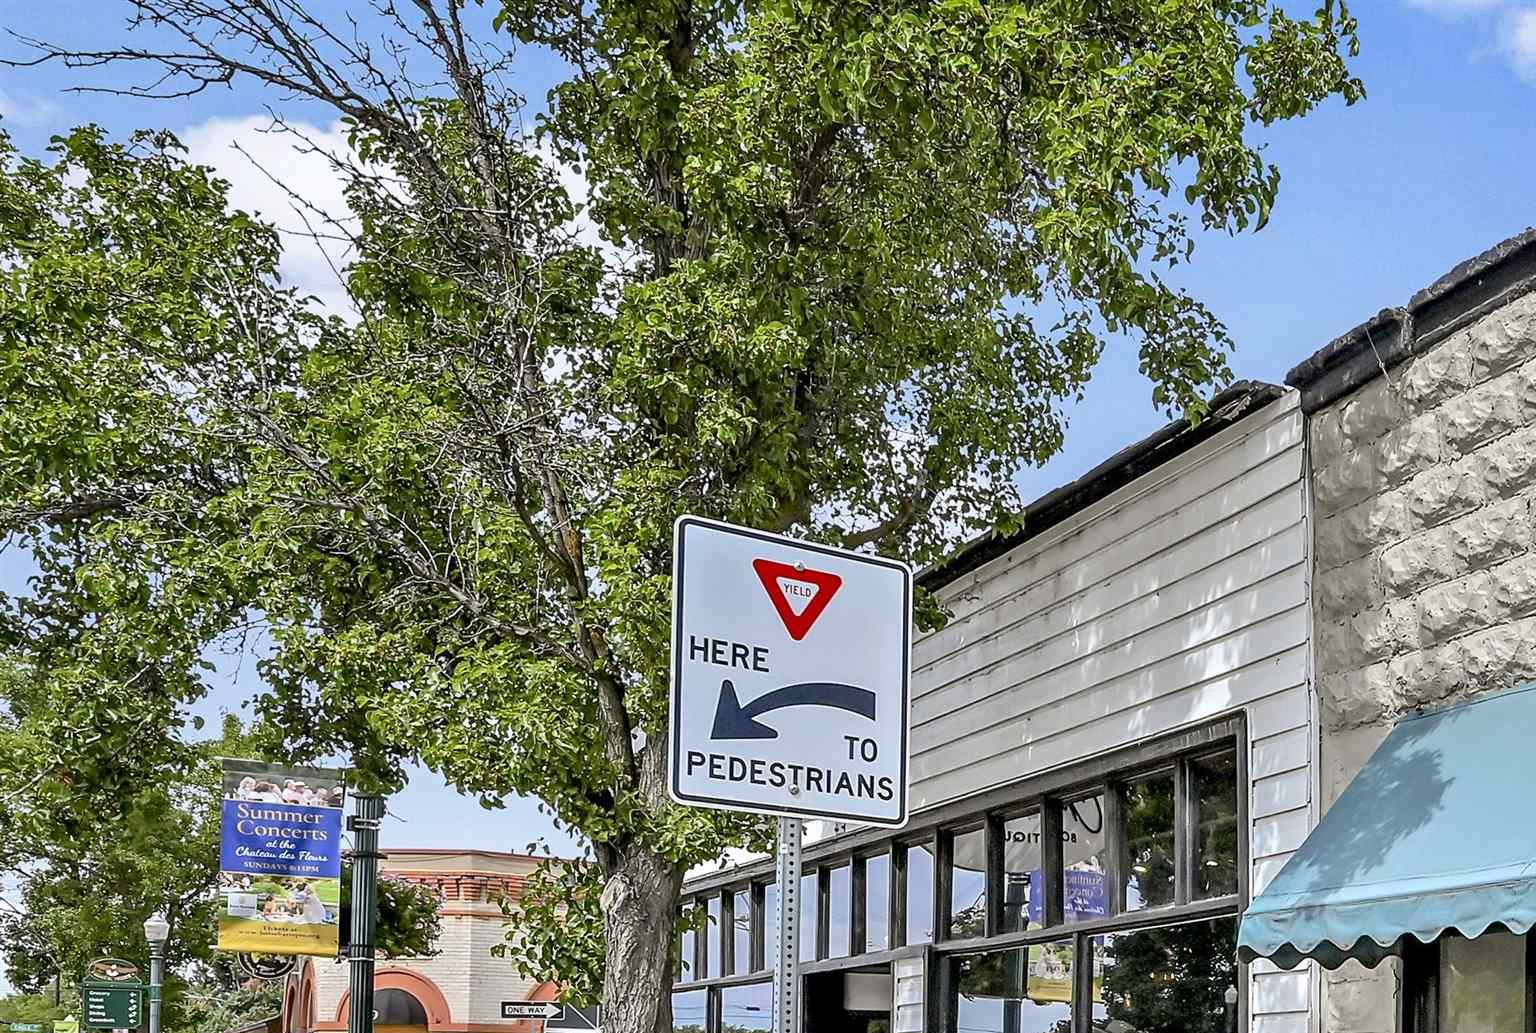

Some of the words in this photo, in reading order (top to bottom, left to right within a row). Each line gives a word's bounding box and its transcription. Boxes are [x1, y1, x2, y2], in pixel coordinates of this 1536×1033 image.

[783, 583, 811, 597] YIELD
[689, 635, 769, 673] HERE
[844, 735, 877, 763] TO
[687, 751, 893, 801] PEDESTRIANS
[237, 803, 324, 824] Summer
[237, 820, 328, 841] Concerts
[235, 846, 277, 858] Chateau
[279, 850, 296, 860] des
[266, 840, 278, 848] at
[279, 840, 296, 850] the
[507, 1006, 524, 1014] ONE
[527, 1006, 545, 1014] WAY
